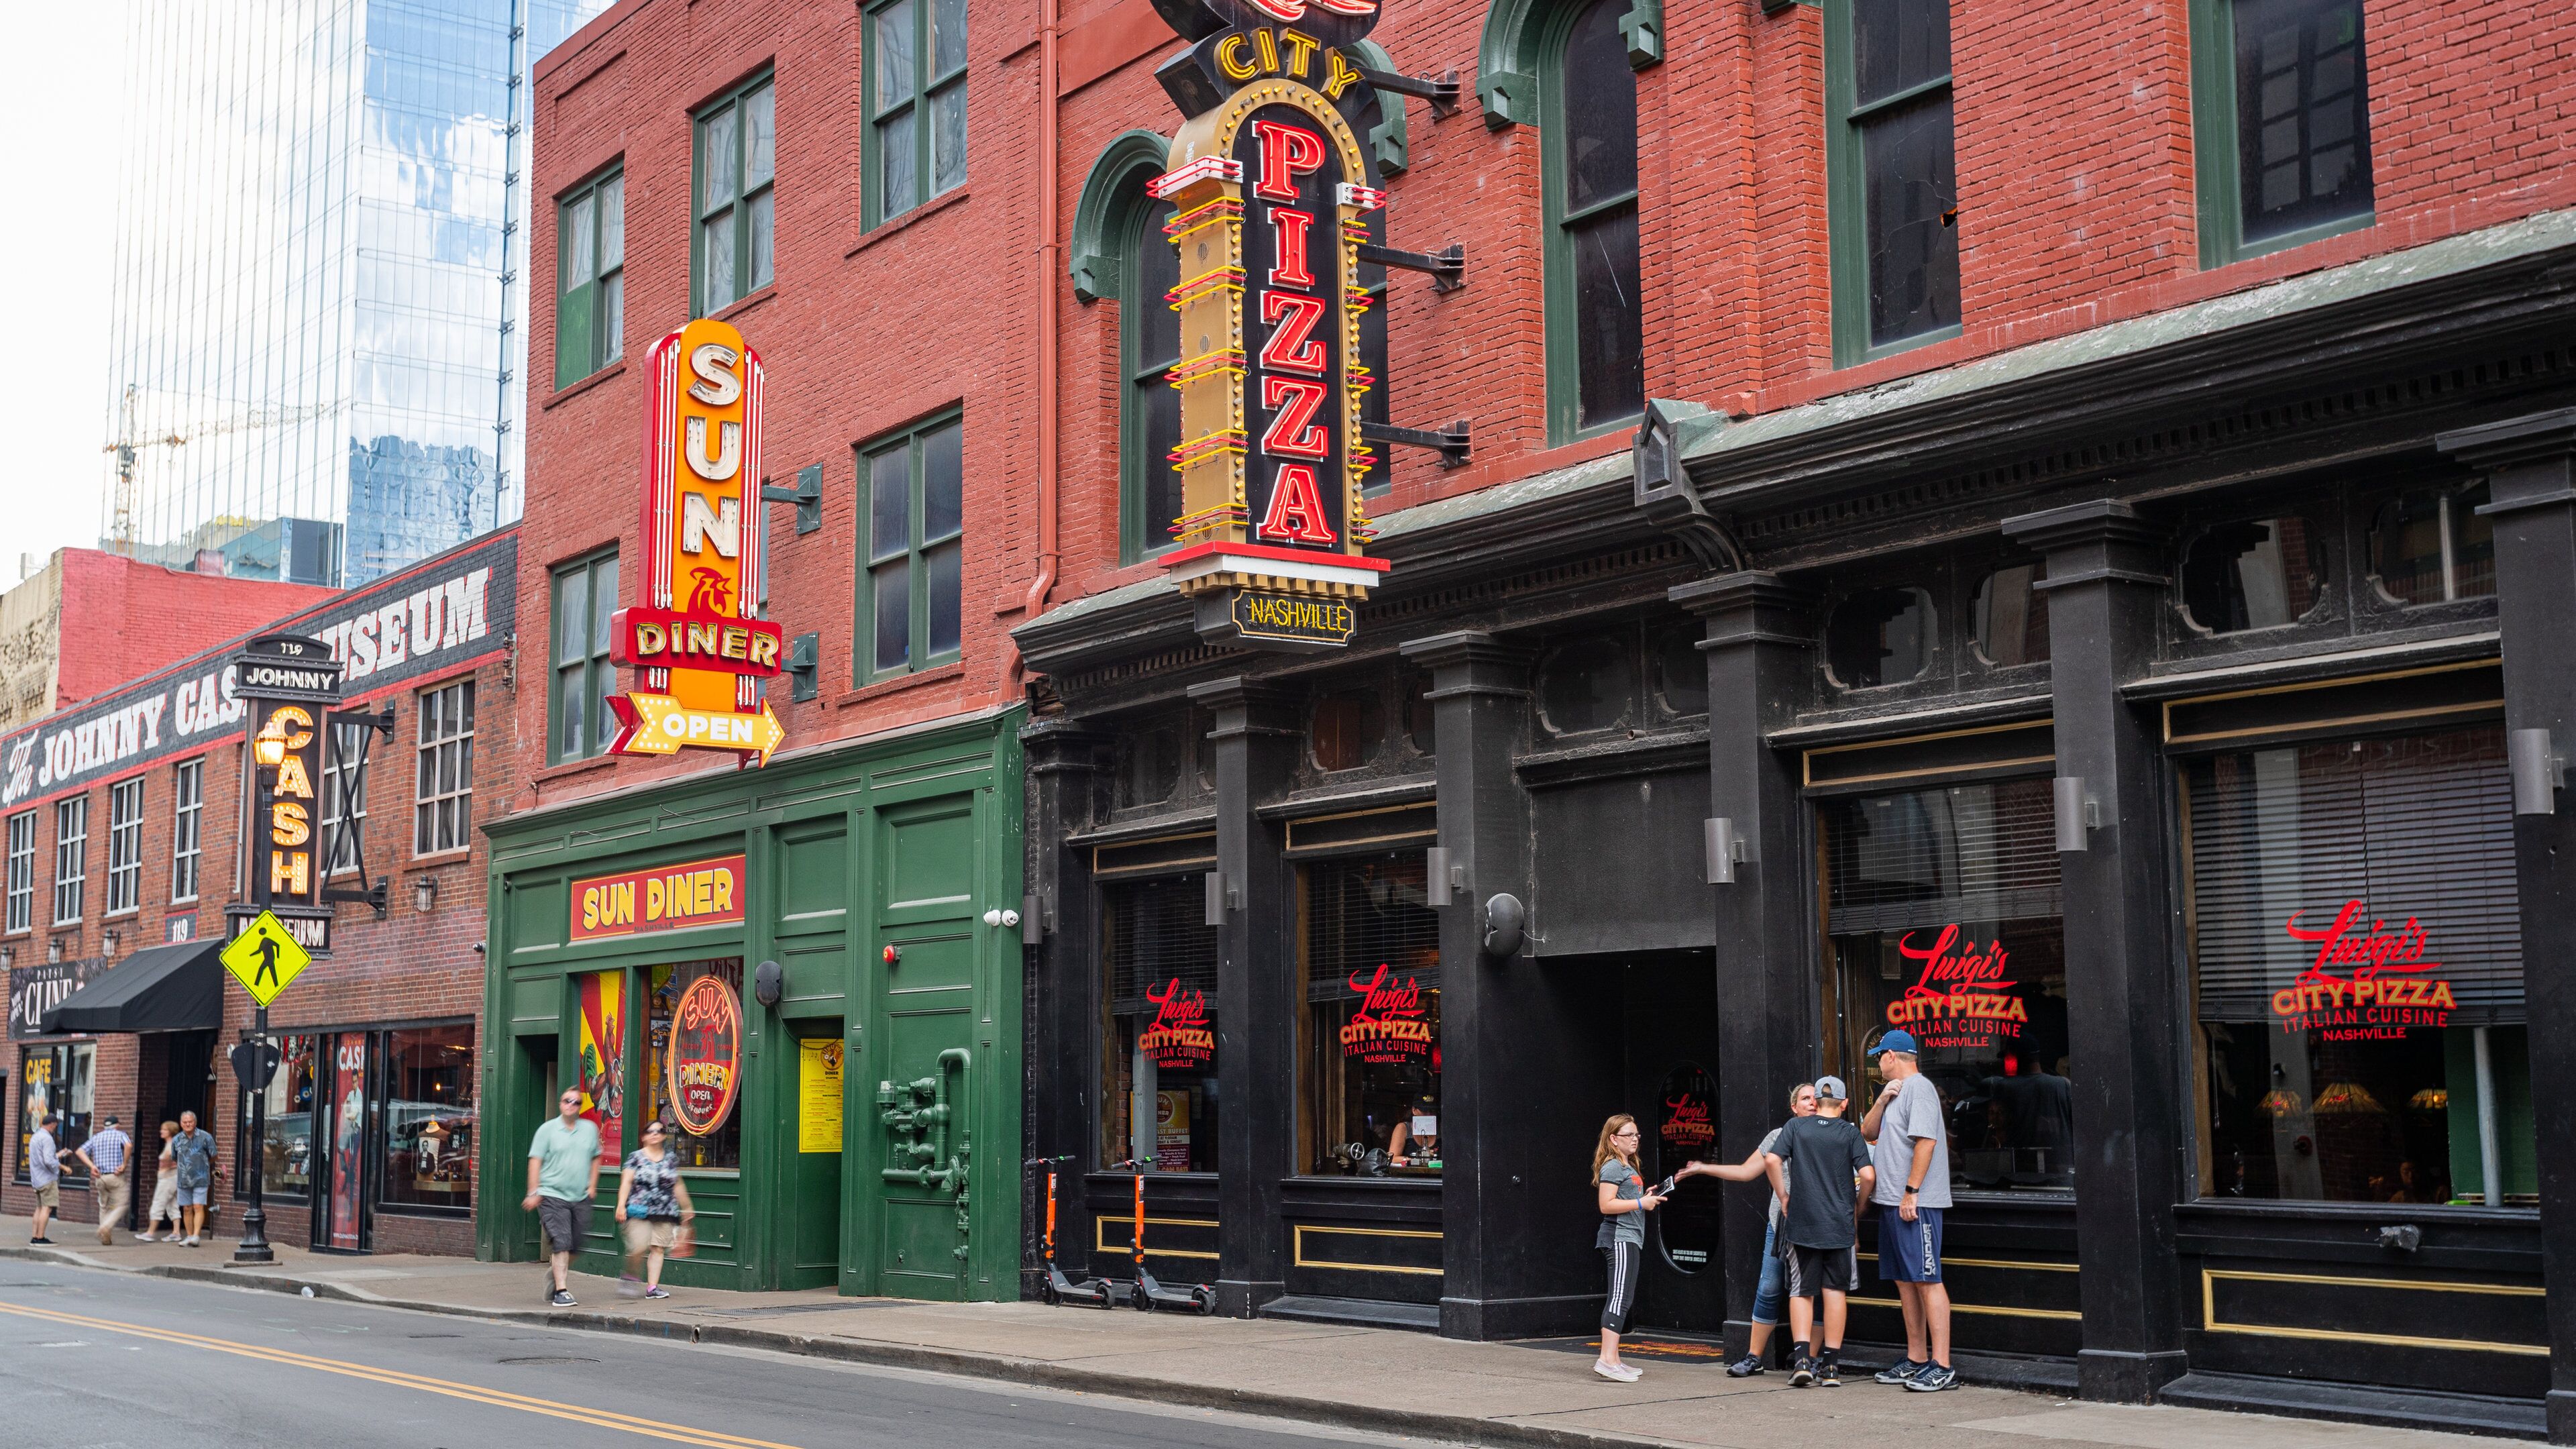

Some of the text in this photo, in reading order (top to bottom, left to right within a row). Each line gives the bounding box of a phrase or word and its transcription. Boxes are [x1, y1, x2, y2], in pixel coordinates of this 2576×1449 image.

[1214, 27, 1365, 100] CITY
[1253, 119, 1337, 546] PIZZA
[680, 342, 741, 557] SUN
[1249, 598, 1348, 632] NASHVILLE
[280, 642, 303, 655] 119
[636, 621, 780, 667] DINER
[3, 567, 491, 807] The JOHNNY CAS USEUM
[246, 667, 335, 690] JOHNNY
[663, 712, 753, 743] OPEN
[271, 706, 314, 894] CASH
[583, 867, 734, 930] SUN DINER
[172, 918, 188, 943] 119
[239, 916, 325, 947] EUM
[634, 922, 674, 933] NASHVILLE
[2286, 900, 2443, 986] Luigi's
[1899, 923, 2018, 999] Luigi's
[1146, 977, 1210, 1032] Luigi's
[1348, 963, 1426, 1023] Luigi's
[2272, 978, 2457, 1016] CITY PIZZA
[685, 987, 730, 1034] SUN
[1887, 994, 2028, 1024] CITY PIZZA
[2283, 1008, 2449, 1034] ITALIAN CUISINE
[1138, 1029, 1214, 1051] CITY PIZZA
[1340, 1020, 1432, 1044] CITY PIZZA
[1925, 1036, 1989, 1047] NASHVILLE
[1958, 1020, 2021, 1038] CUISINE
[2323, 1027, 2406, 1041] NASHVILLE
[1143, 1047, 1211, 1062] ITALIAN CUISINE
[1344, 1041, 1427, 1057] ITALIAN CUISINE
[1364, 1055, 1406, 1063] NASHVILLE
[26, 1059, 52, 1084] CAFE
[679, 1062, 729, 1091] DINER
[1159, 1060, 1193, 1068] NASHVILLE
[691, 1090, 712, 1101] OPEN
[1158, 1097, 1169, 1106] UN
[1666, 1093, 1711, 1124] Luigi's
[1661, 1123, 1715, 1136] CITY PIZZA
